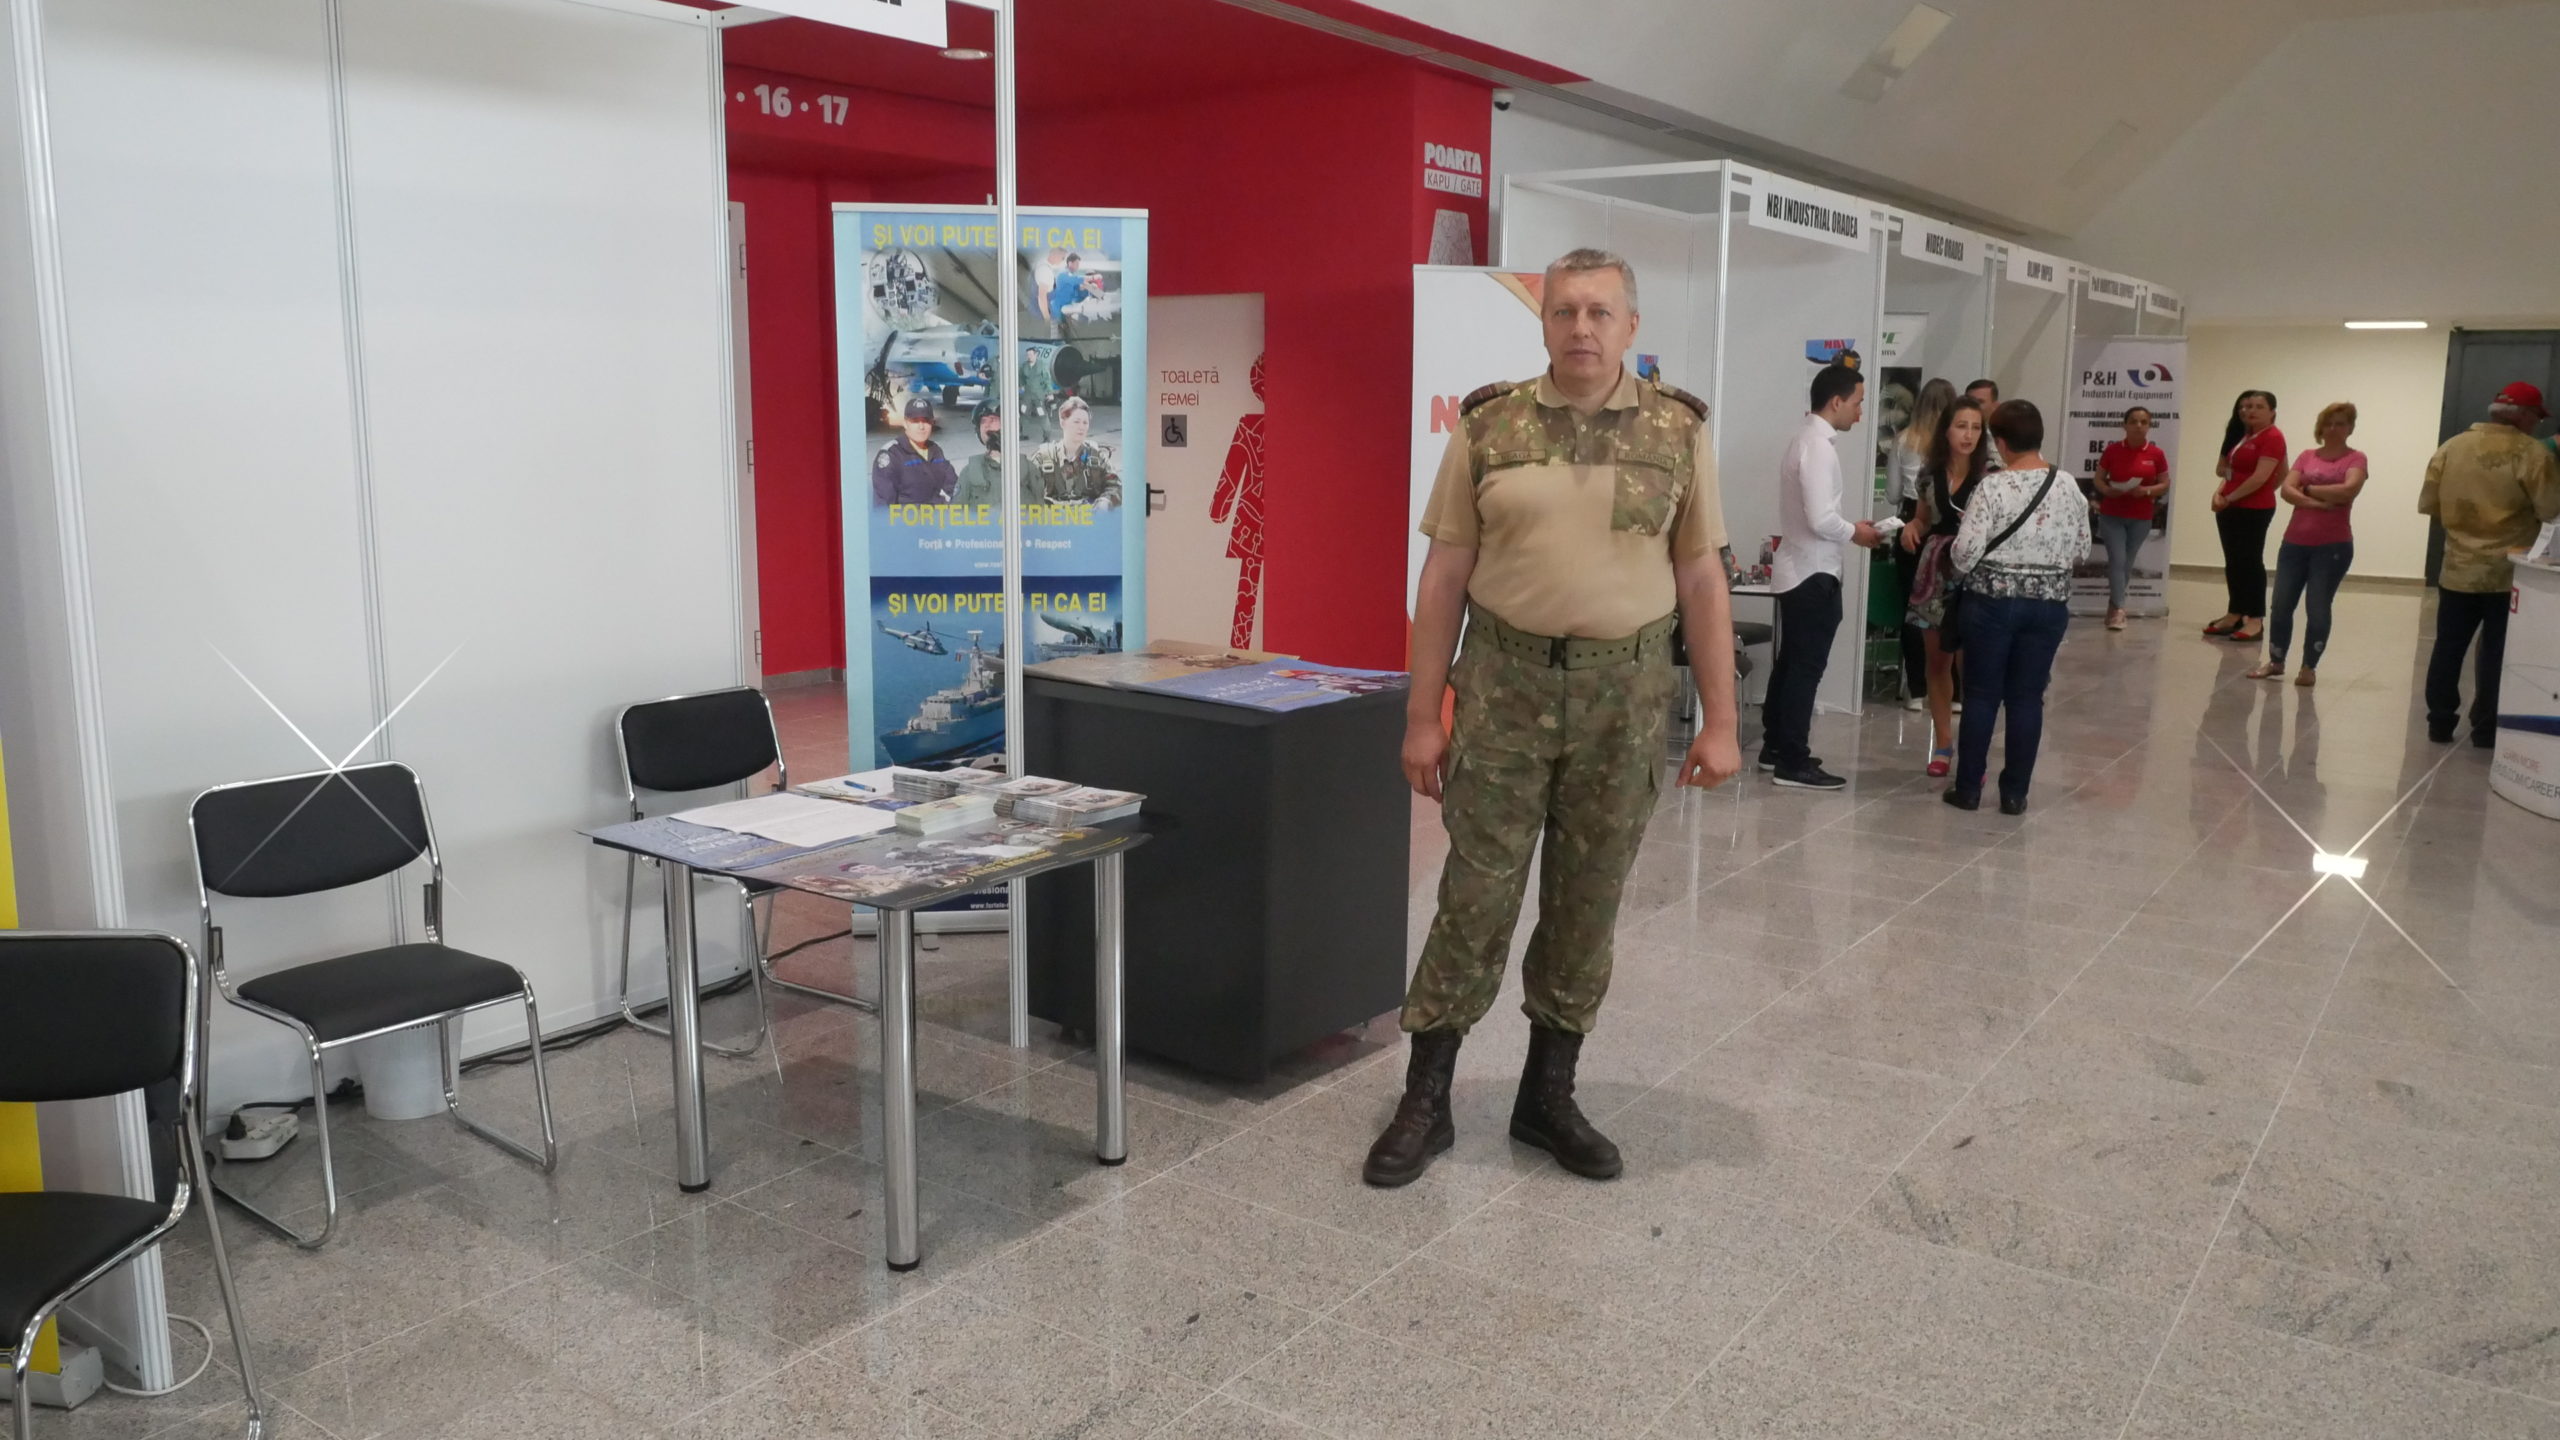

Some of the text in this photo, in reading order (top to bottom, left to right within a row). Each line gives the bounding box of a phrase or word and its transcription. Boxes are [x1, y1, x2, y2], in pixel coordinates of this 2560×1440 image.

[754, 84, 849, 126] 16 17
[1424, 142, 1482, 175] POARTA
[1427, 168, 1450, 190] KAPU
[1460, 175, 1482, 196] GATE
[1767, 193, 1858, 239] NBI INDUSTRIAL ORADEA
[901, 225, 936, 247] VOI
[1023, 226, 1041, 248] FI
[1048, 225, 1076, 248] CA
[1084, 226, 1102, 249] EI
[1925, 232, 1944, 256] NIDEC
[2083, 370, 2117, 386] P&H
[2082, 389, 2173, 401] Industrial Equipment
[2089, 440, 2105, 453] BE
[998, 504, 1094, 526] ERIENE
[1035, 538, 1071, 550] Respect
[913, 593, 947, 614] VOI
[1031, 593, 1048, 613] FI
[1054, 592, 1082, 613] CA
[1089, 592, 1106, 612] EI
